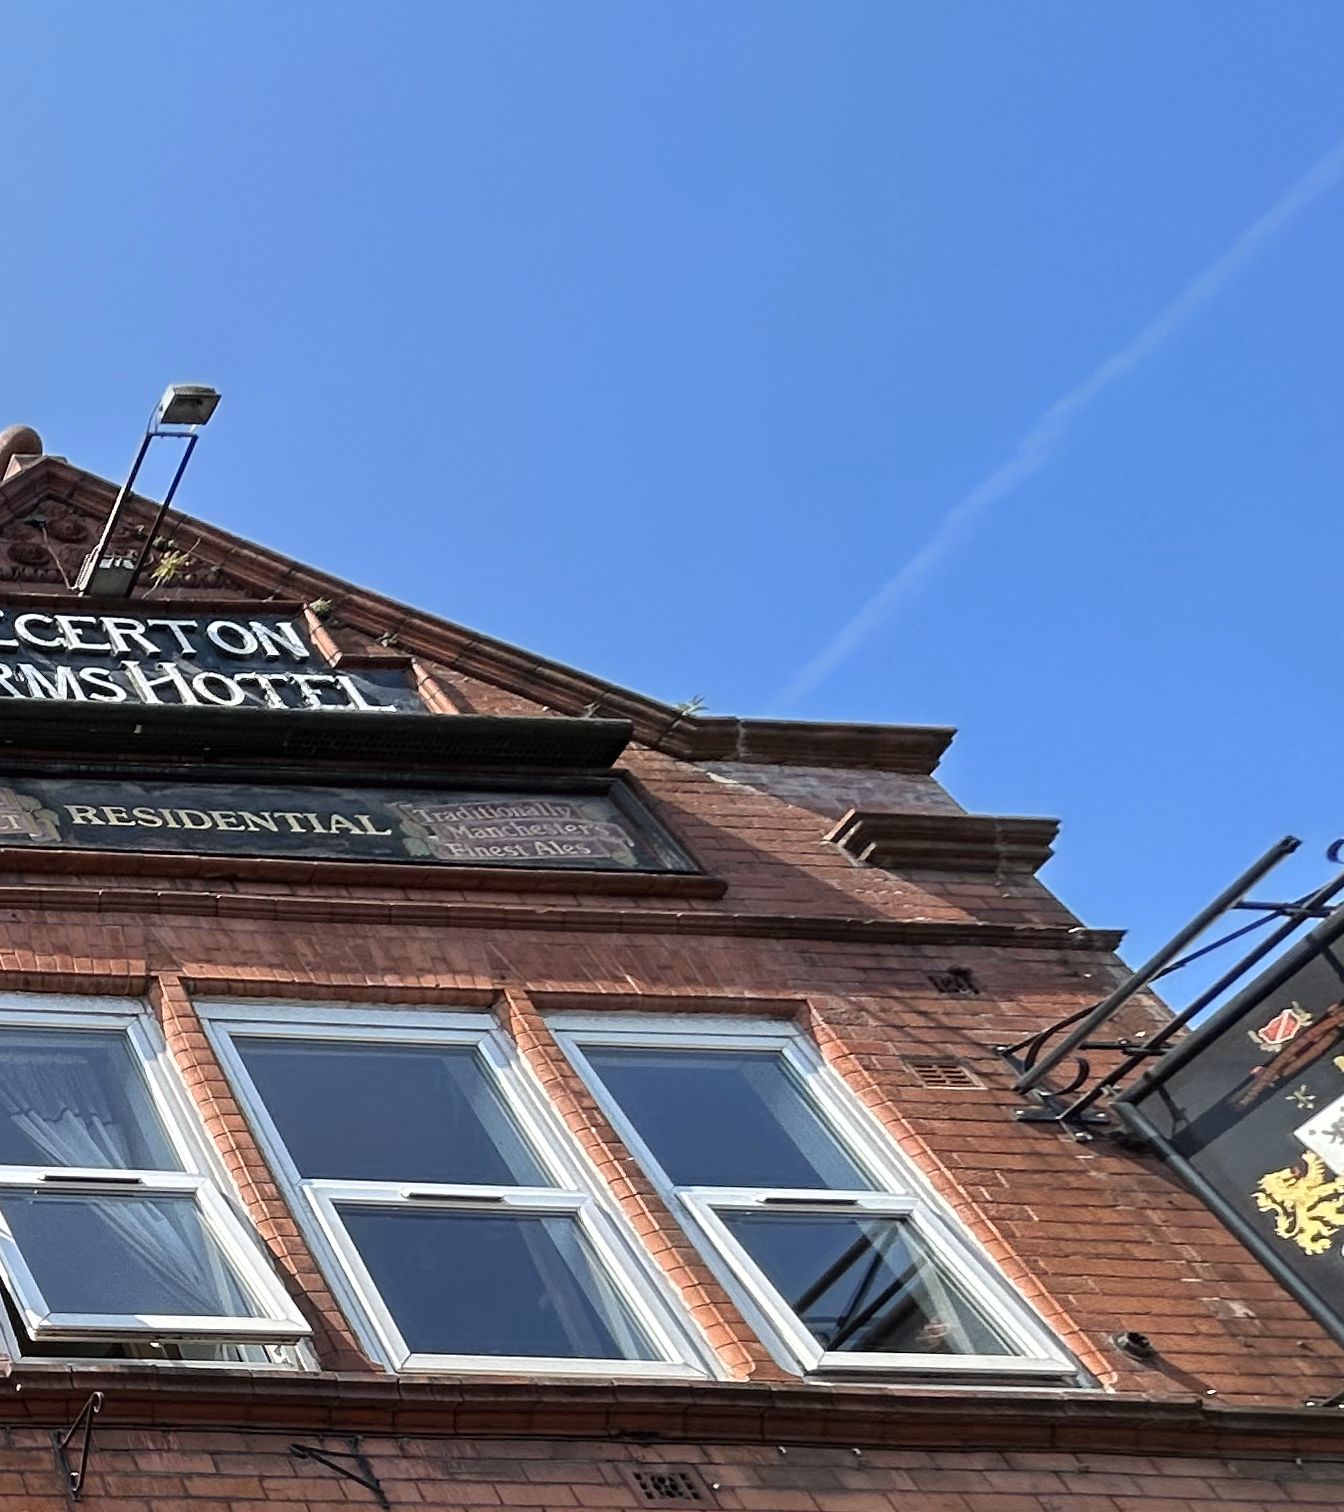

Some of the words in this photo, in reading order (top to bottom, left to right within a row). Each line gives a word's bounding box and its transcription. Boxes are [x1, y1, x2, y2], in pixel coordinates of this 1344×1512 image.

[118, 659, 397, 712] HOTEL
[64, 804, 392, 836] RESIDENTIAL
[413, 800, 571, 824] Traditionally
[444, 821, 610, 841] Manchester's
[444, 840, 530, 858] Finest
[534, 840, 592, 857] Ales
